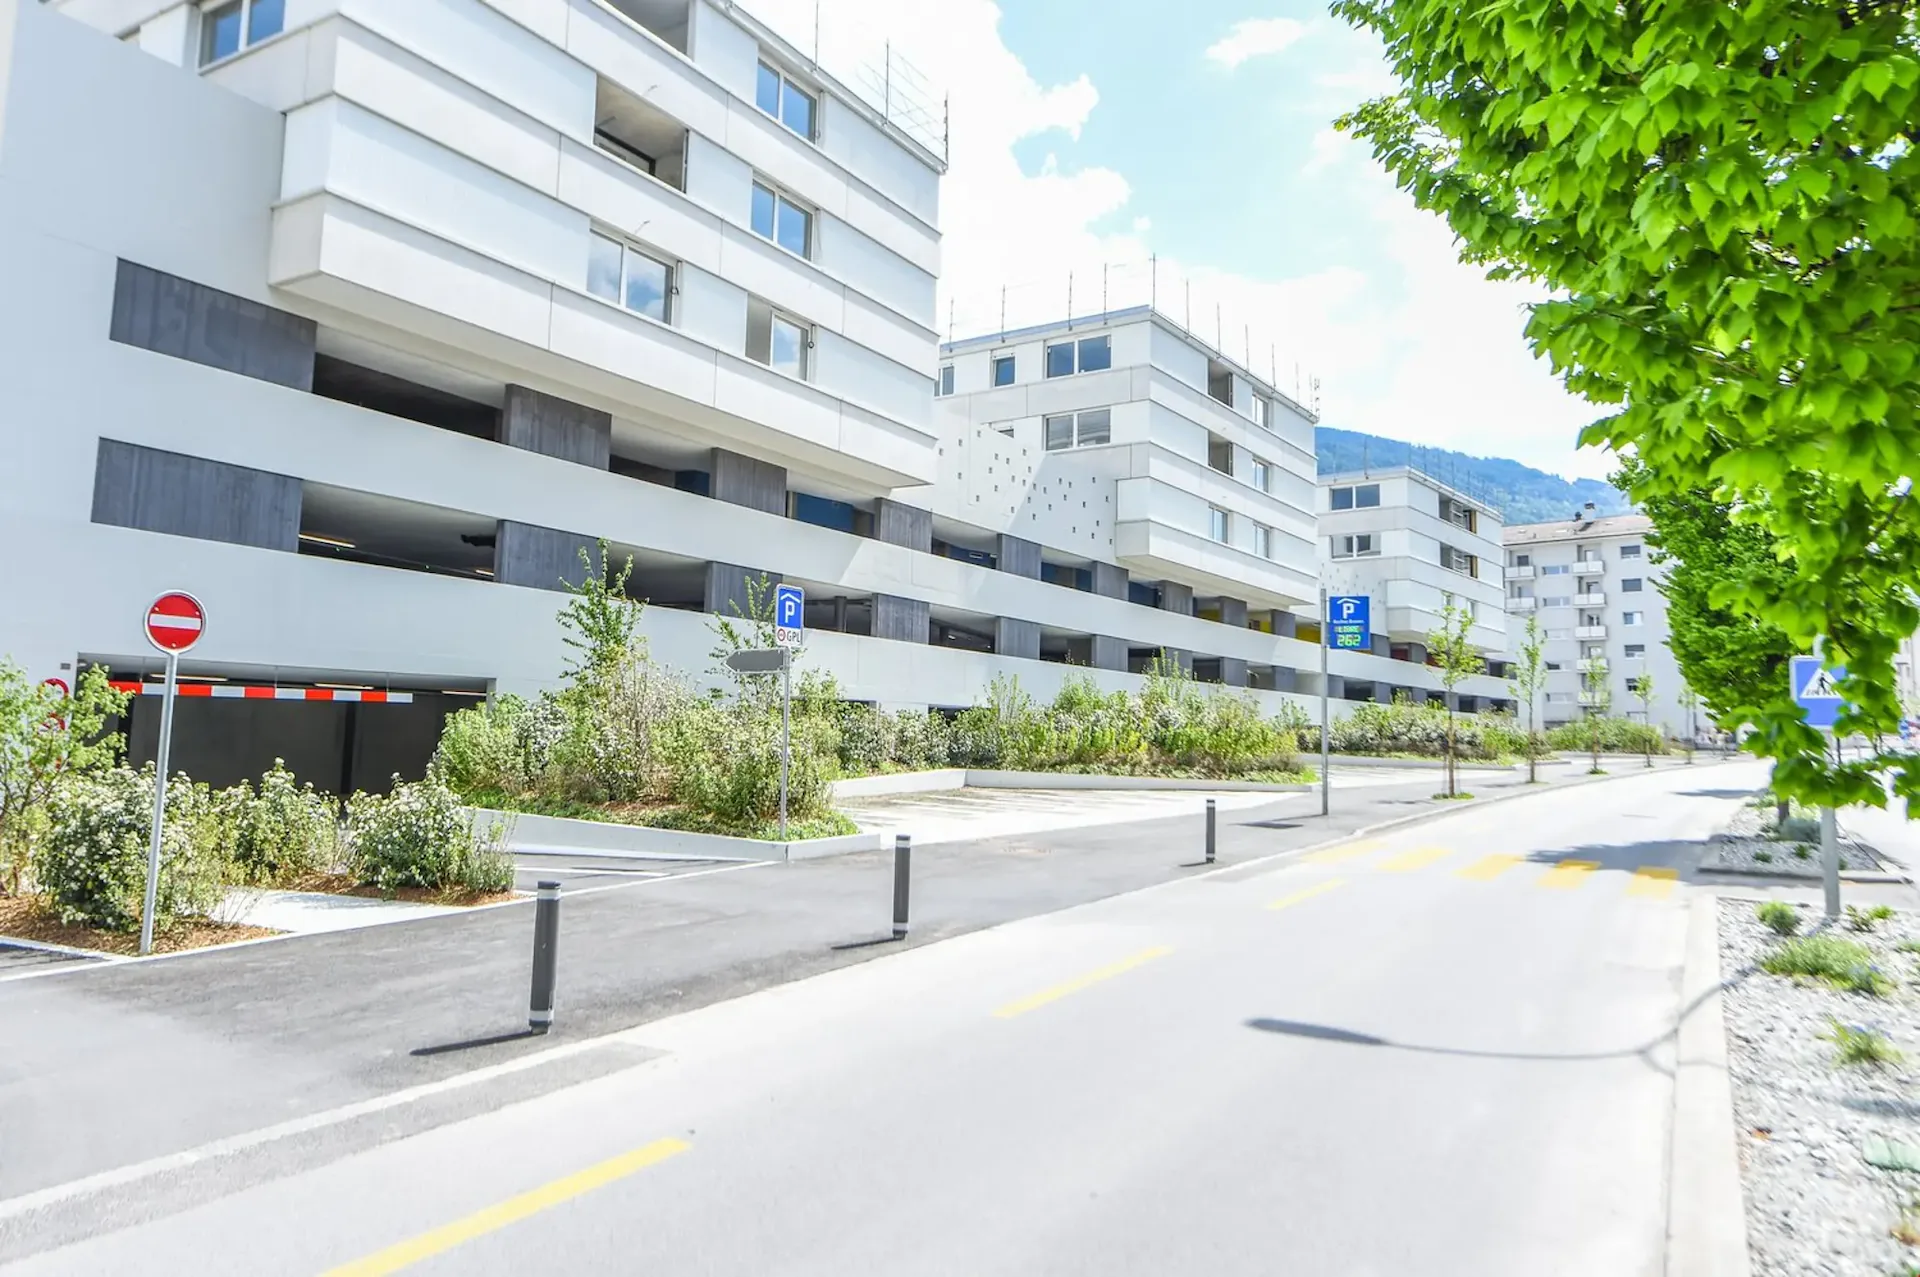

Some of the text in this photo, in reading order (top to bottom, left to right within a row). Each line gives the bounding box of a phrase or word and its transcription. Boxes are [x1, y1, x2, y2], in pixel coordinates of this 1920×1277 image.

[785, 602, 795, 623] P
[1343, 603, 1355, 619] P
[787, 631, 800, 643] GPL
[1337, 634, 1361, 647] 262
